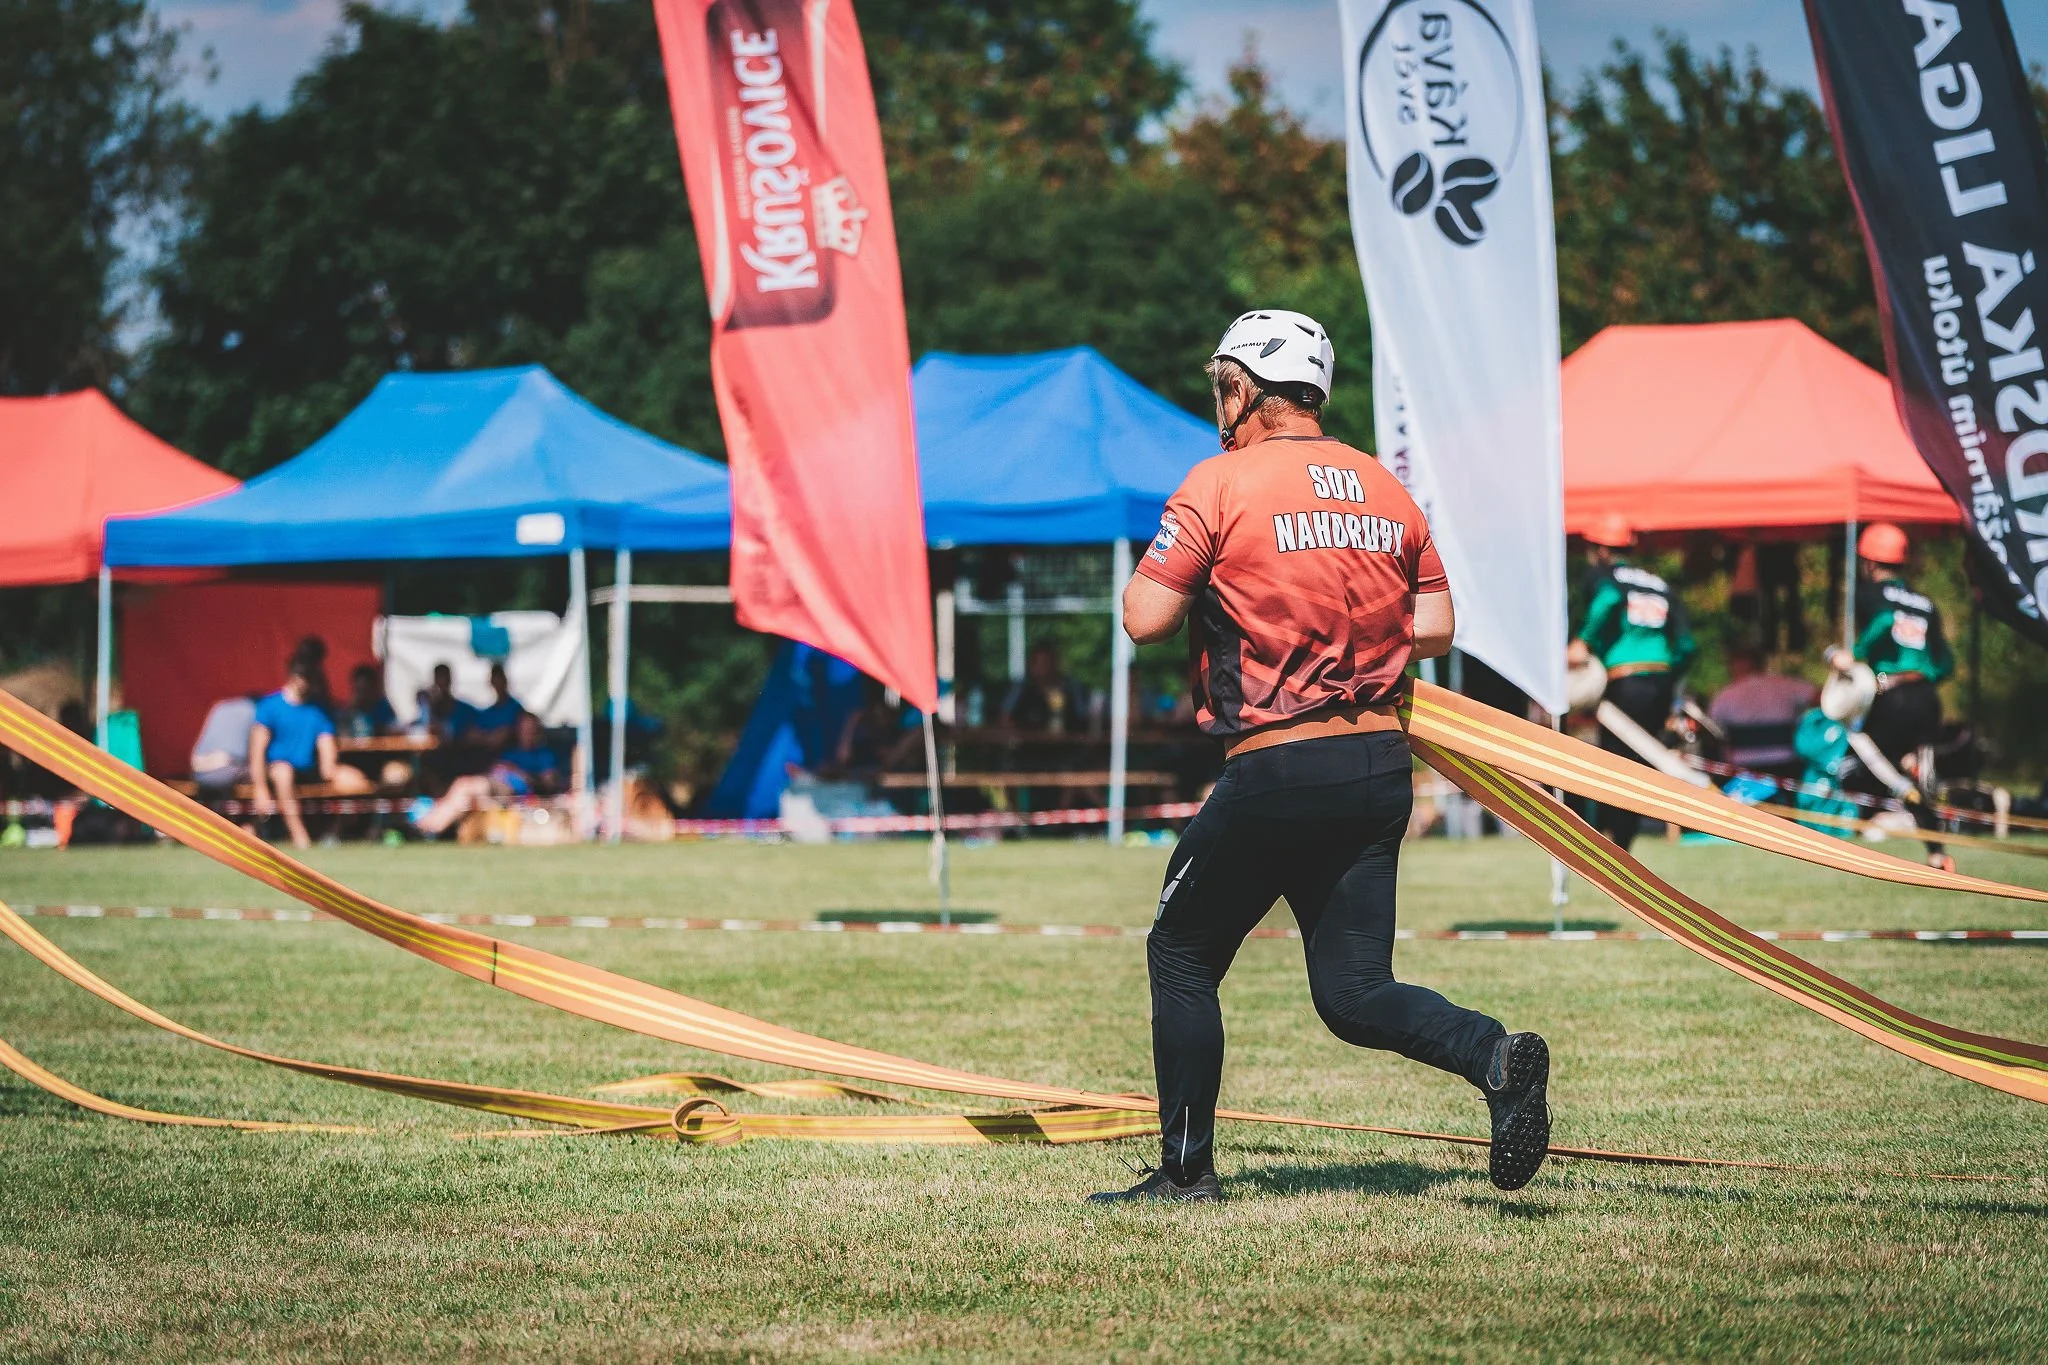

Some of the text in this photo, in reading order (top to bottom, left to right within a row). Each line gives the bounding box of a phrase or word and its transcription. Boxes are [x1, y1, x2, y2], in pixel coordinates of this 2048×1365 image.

[1230, 341, 1267, 351] MAMMUT
[1307, 464, 1366, 503] SDH
[1273, 511, 1405, 558] NAHORUBY
